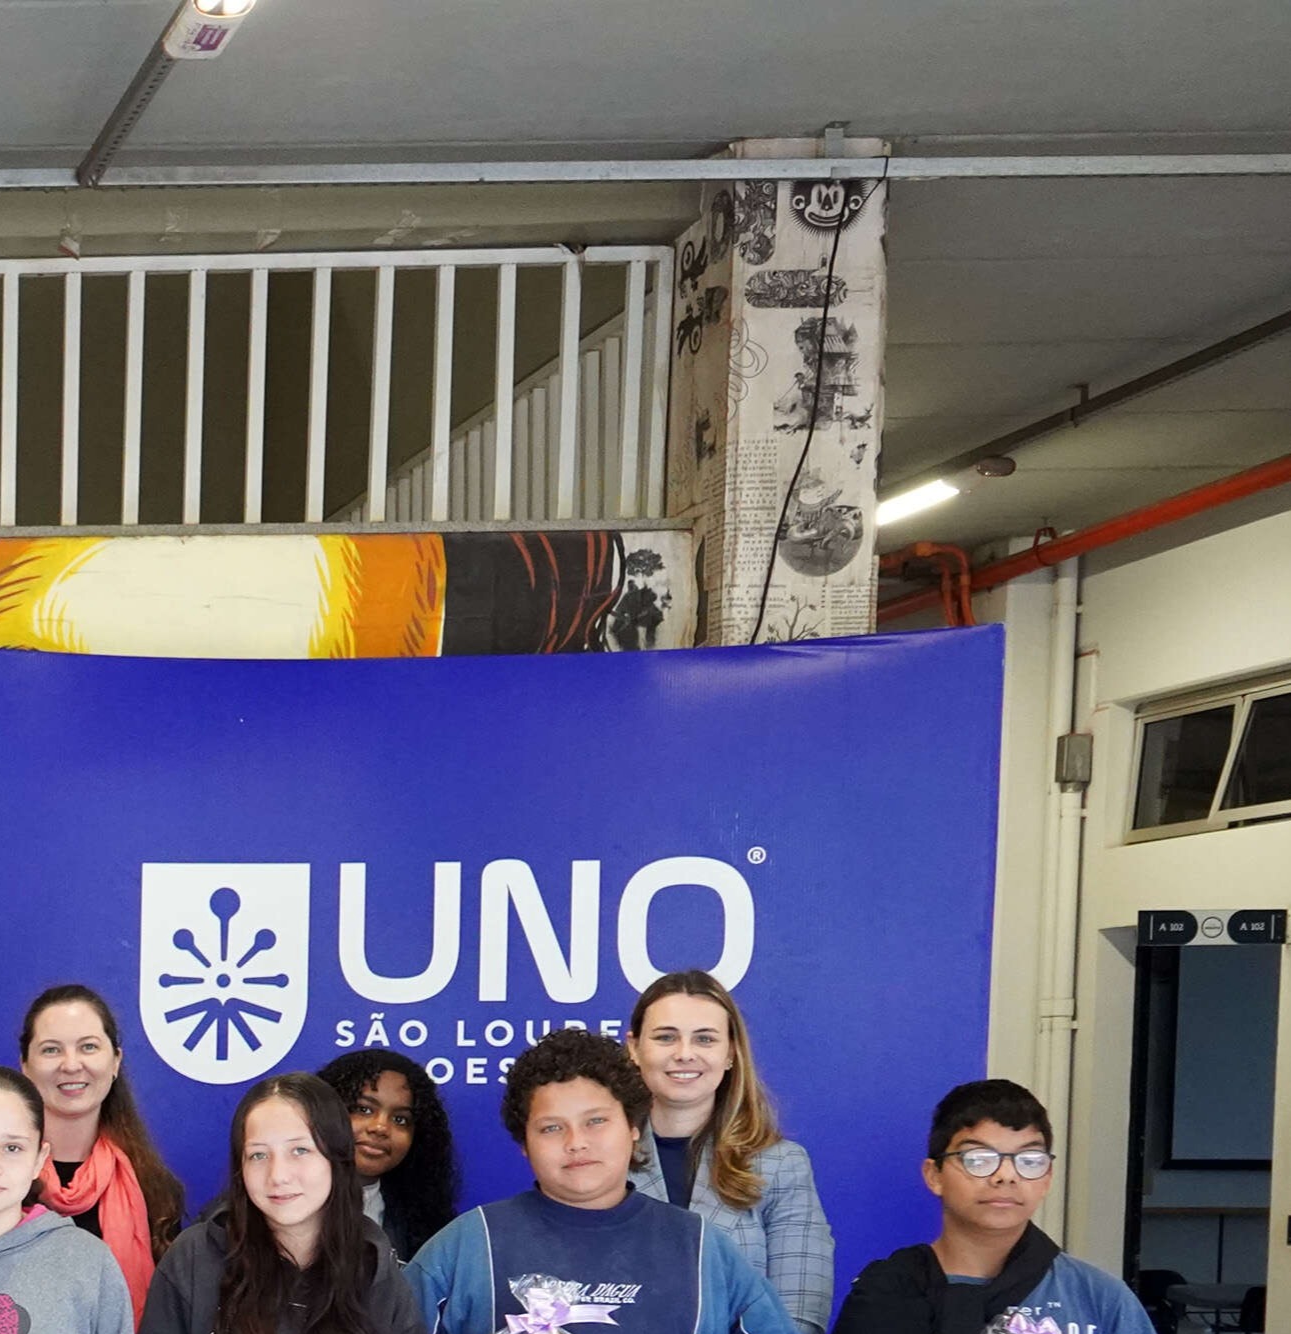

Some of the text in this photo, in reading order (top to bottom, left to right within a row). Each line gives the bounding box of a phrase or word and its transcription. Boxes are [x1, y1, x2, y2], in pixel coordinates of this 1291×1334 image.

[338, 855, 756, 1005] UNO
[1169, 923, 1185, 931] 102
[1250, 922, 1265, 931] 102
[335, 1012, 429, 1048] SÃO
[425, 1057, 517, 1085] OES
